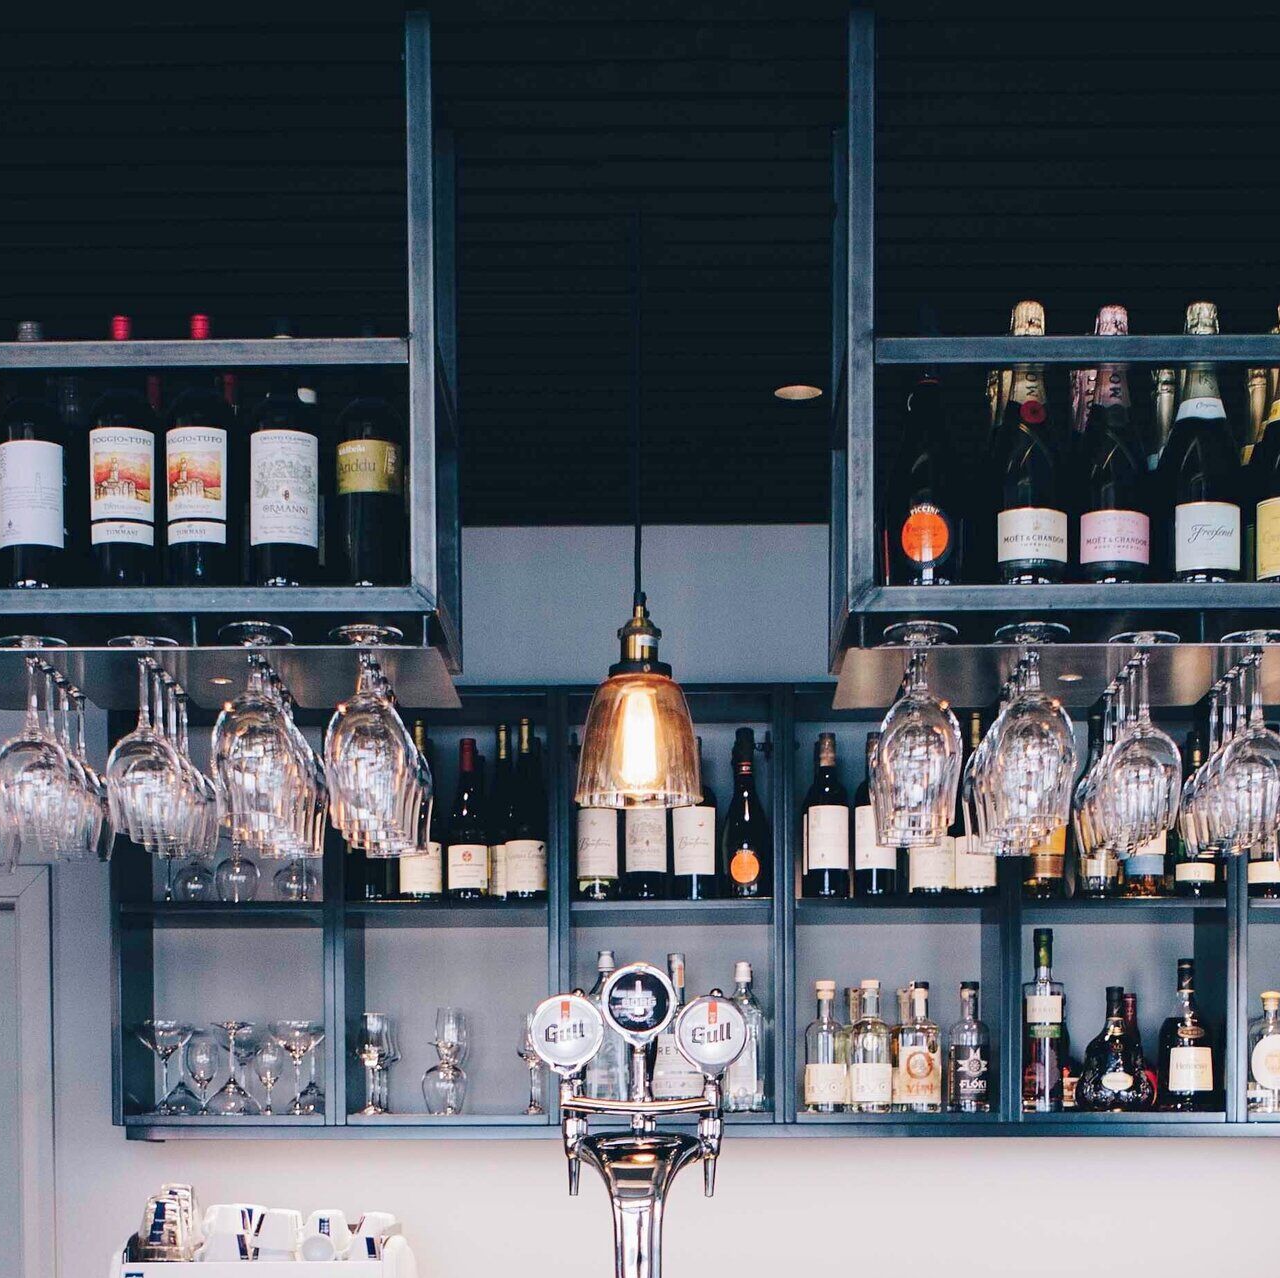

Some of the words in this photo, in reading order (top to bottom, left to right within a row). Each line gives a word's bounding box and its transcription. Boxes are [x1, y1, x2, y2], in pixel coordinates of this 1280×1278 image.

[128, 435, 152, 447] TUFO
[195, 435, 223, 444] TUFO
[262, 504, 309, 515] ORMANNI
[1003, 534, 1025, 544] MOËT
[1030, 534, 1065, 545] CHANDON
[1086, 537, 1107, 545] MOËT
[1113, 537, 1148, 547] CHANDON
[544, 1021, 586, 1045] Gull
[691, 1021, 733, 1046] Gull
[959, 1078, 987, 1090] FLÓKI
